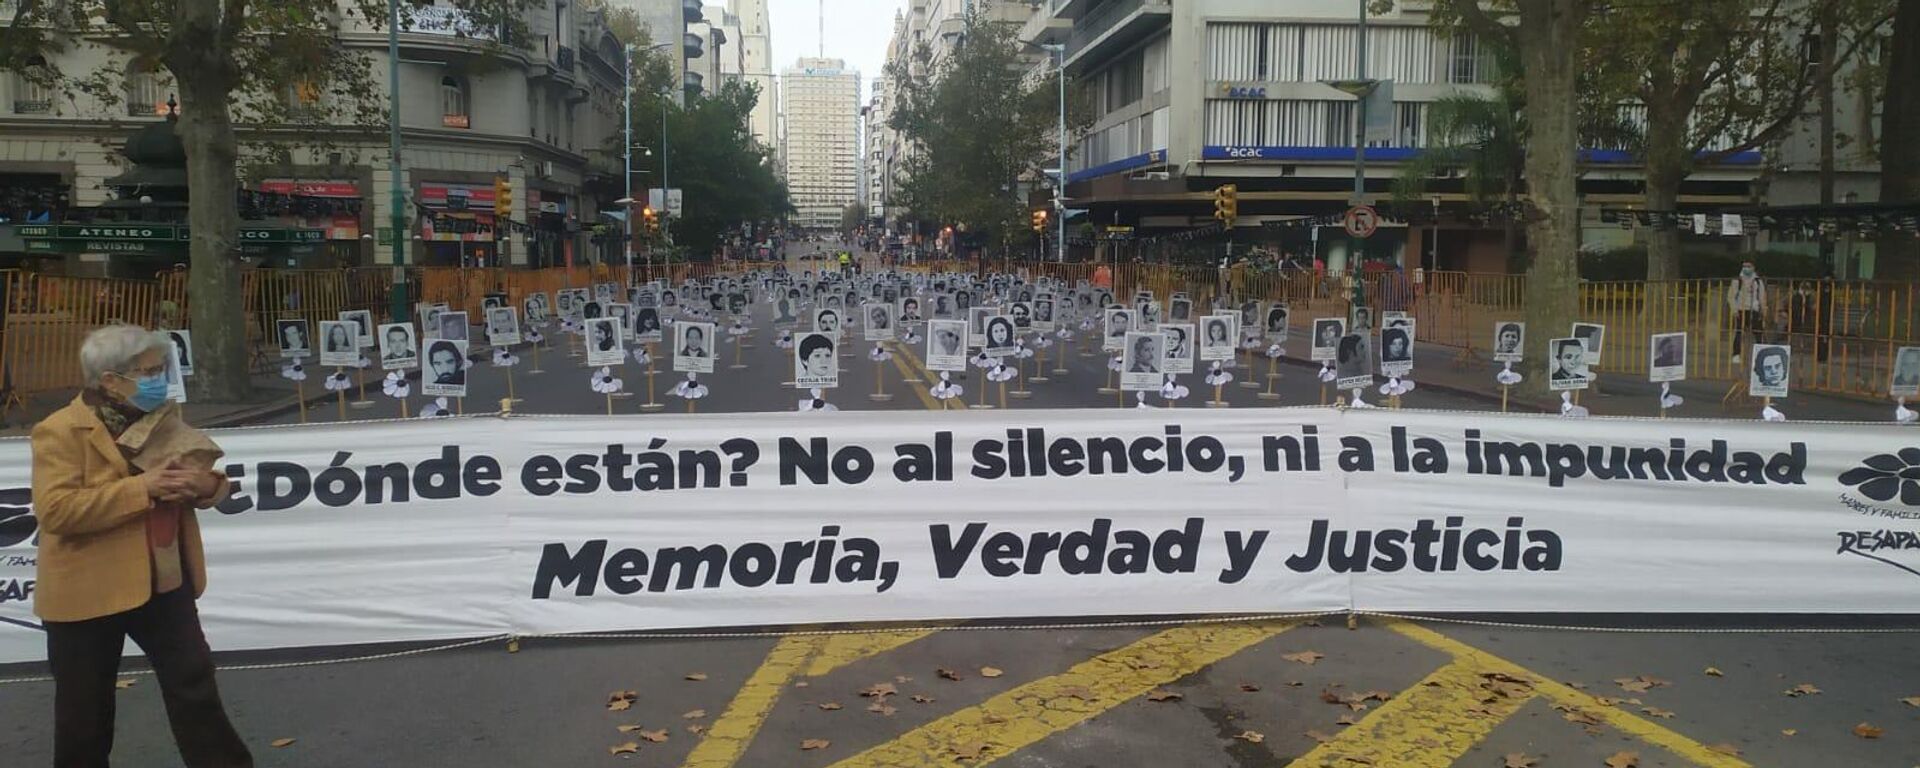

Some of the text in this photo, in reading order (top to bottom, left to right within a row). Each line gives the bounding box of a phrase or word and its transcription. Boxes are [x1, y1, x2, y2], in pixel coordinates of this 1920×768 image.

[1230, 148, 1262, 157] acac
[79, 228, 152, 237] ATENEO
[87, 241, 144, 250] REVISTAS
[521, 438, 760, 496] están?
[778, 437, 875, 486] No
[892, 431, 954, 482] al
[971, 425, 1246, 483] silencio,
[1262, 425, 1321, 472] ni
[1338, 436, 1375, 472] a
[1391, 426, 1448, 473] la
[1465, 429, 1807, 488] impunidad
[532, 516, 1563, 600] Memoria, Verdad y Justicia
